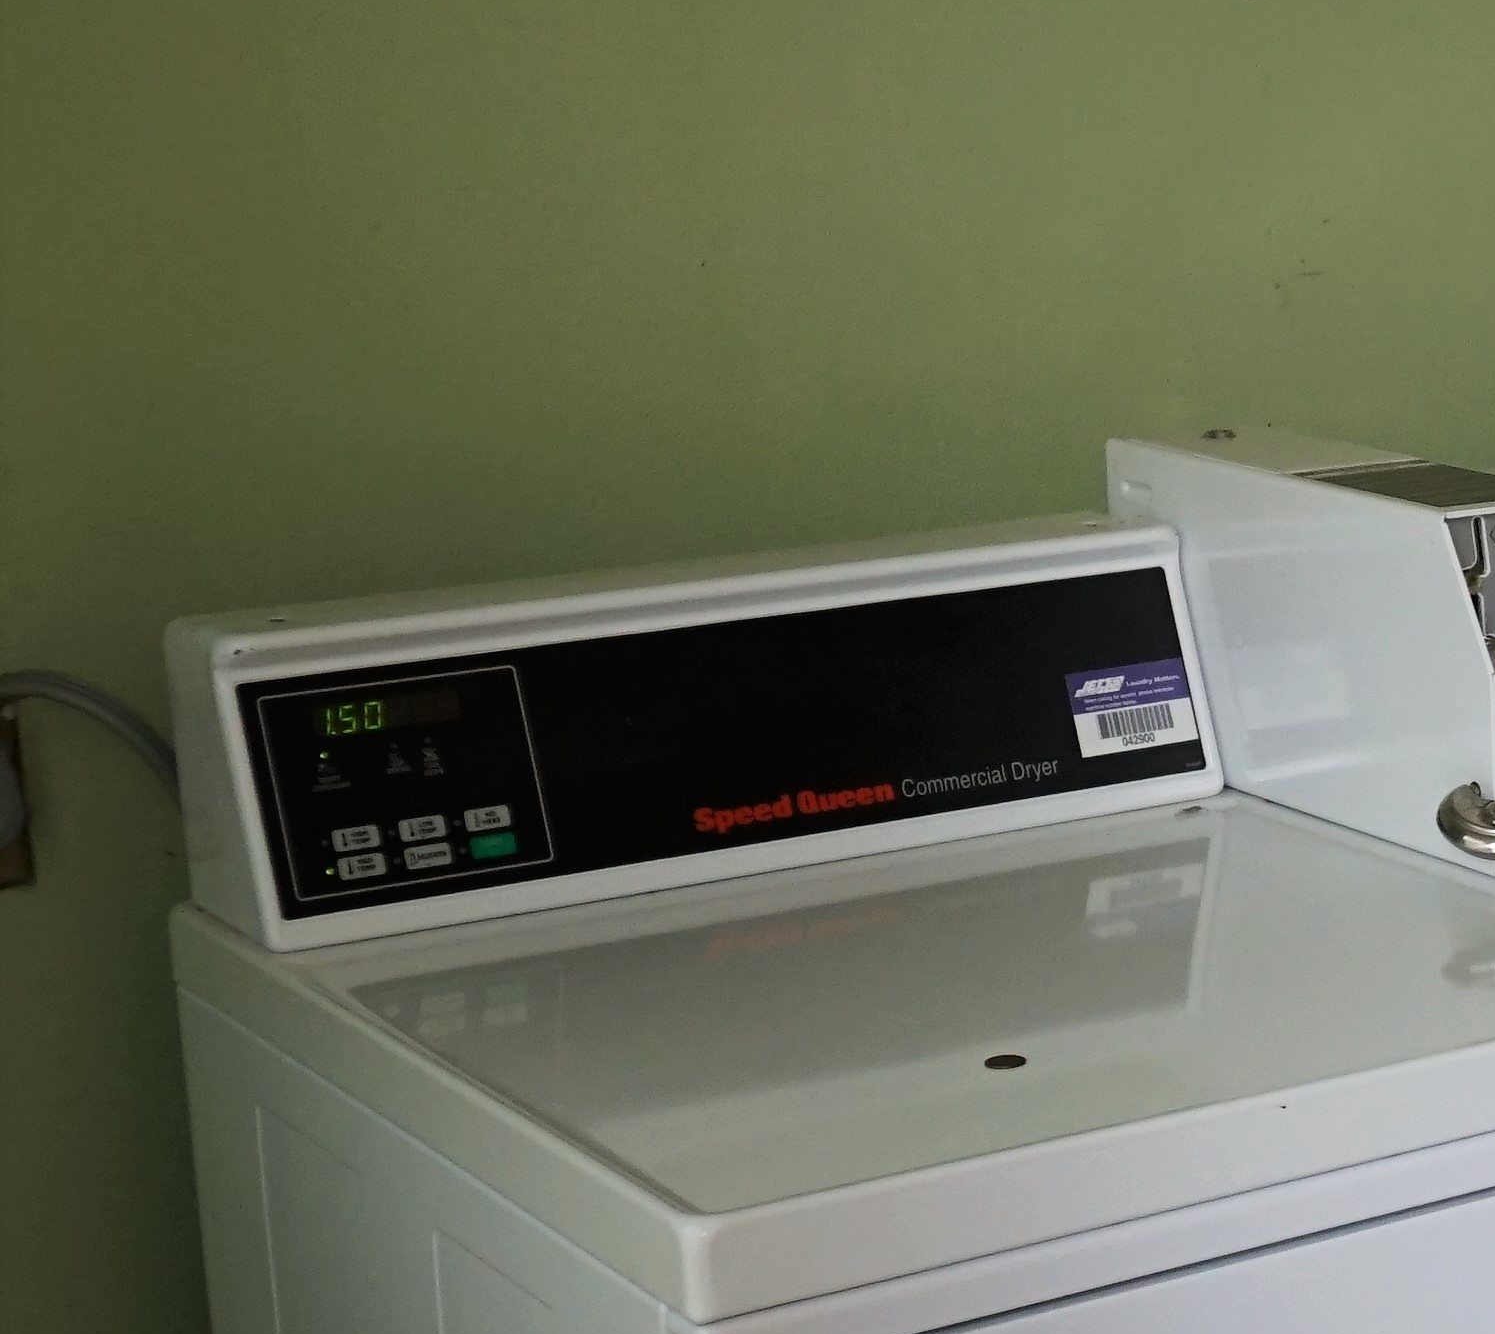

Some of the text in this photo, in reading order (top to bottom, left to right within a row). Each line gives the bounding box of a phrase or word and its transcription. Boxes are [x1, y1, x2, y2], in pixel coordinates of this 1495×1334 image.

[326, 701, 382, 736] 1.50
[1121, 733, 1156, 747] 042900
[692, 758, 1059, 834] Speed Queen Commercial Dryer
